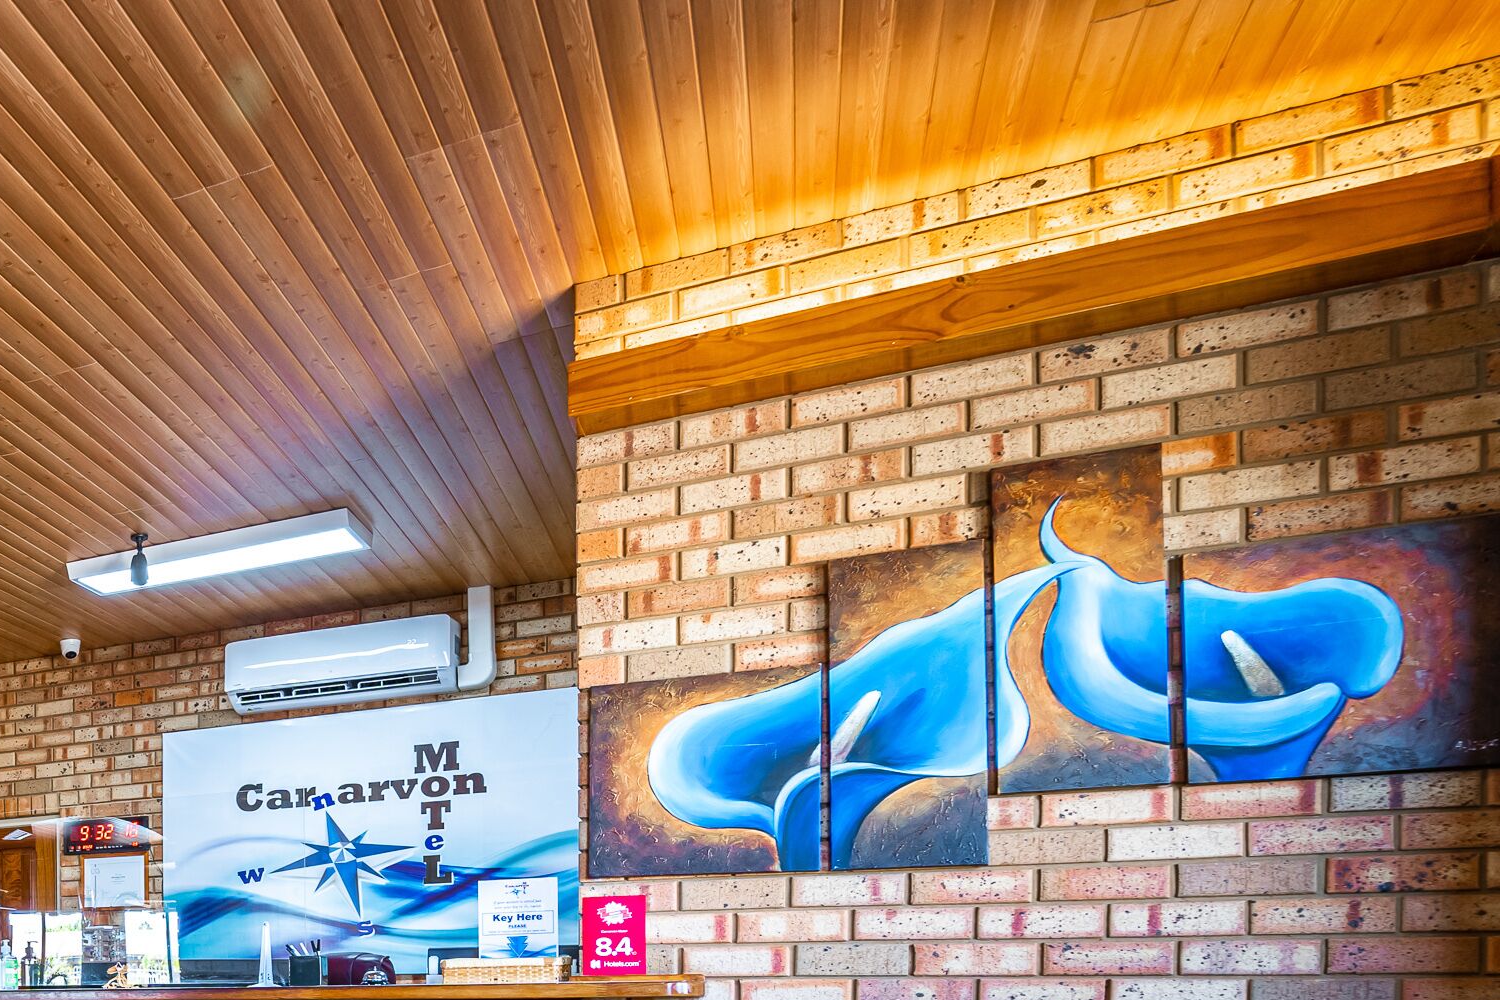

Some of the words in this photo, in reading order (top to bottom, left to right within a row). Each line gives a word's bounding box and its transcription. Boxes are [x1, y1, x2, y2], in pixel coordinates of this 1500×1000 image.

[236, 771, 487, 812] Carnarvon
[80, 824, 114, 841] 9:32
[492, 914, 514, 923] Key
[516, 913, 543, 921] Here
[595, 936, 633, 957] 8.4
